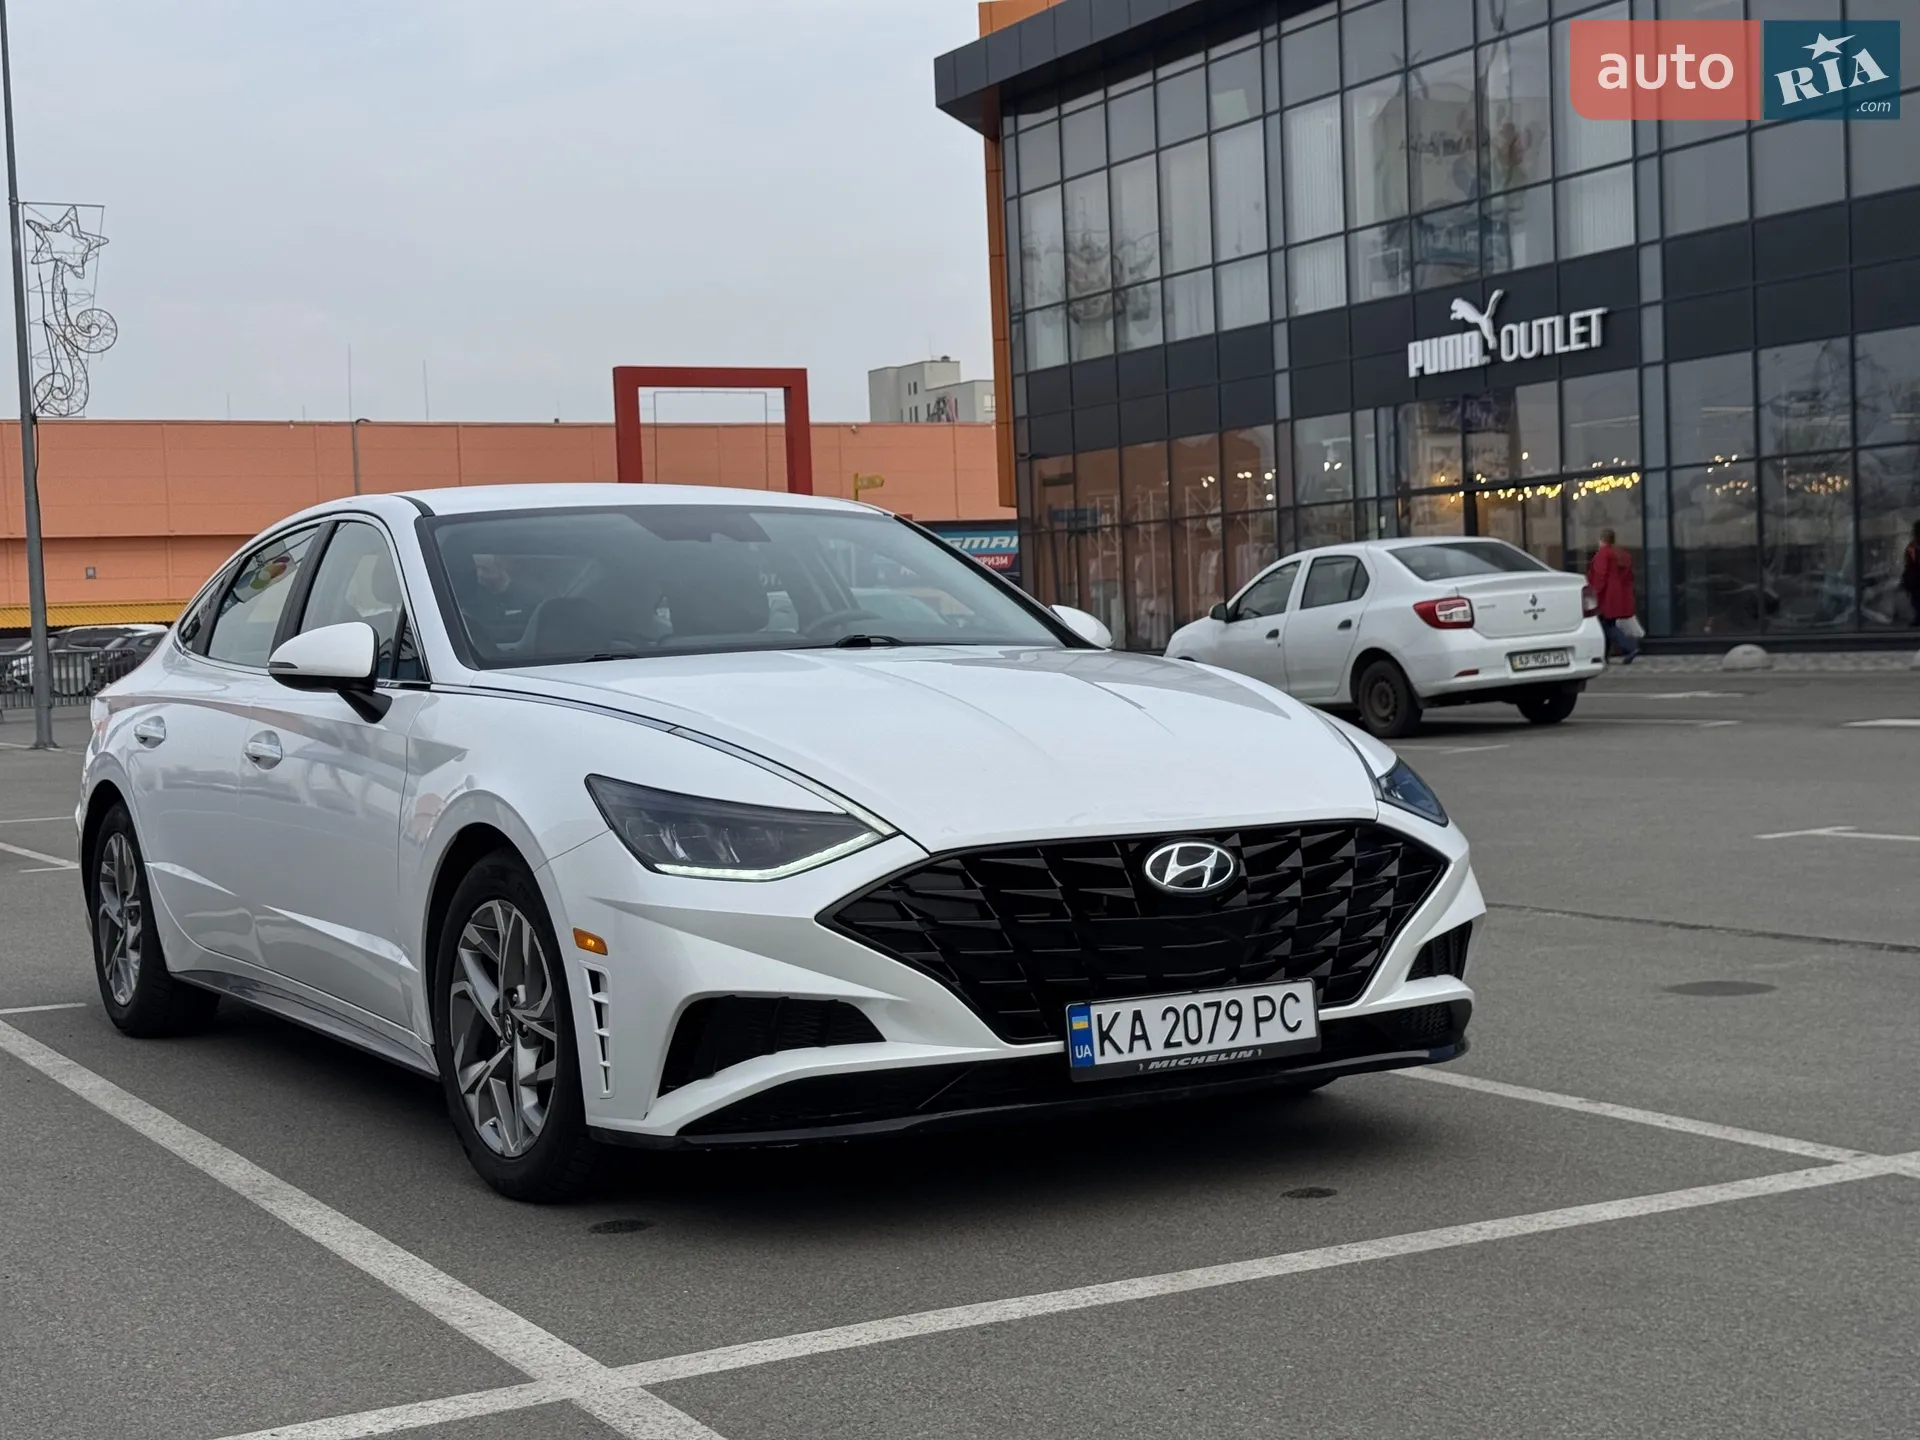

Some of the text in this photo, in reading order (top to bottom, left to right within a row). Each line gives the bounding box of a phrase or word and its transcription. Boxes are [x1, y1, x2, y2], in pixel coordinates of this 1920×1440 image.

[1408, 307, 1609, 378] PUMA OUTLET
[1097, 992, 1303, 1056] KA 2079 PC
[1075, 1044, 1093, 1059] UA
[1148, 1049, 1254, 1070] MICHELIN
